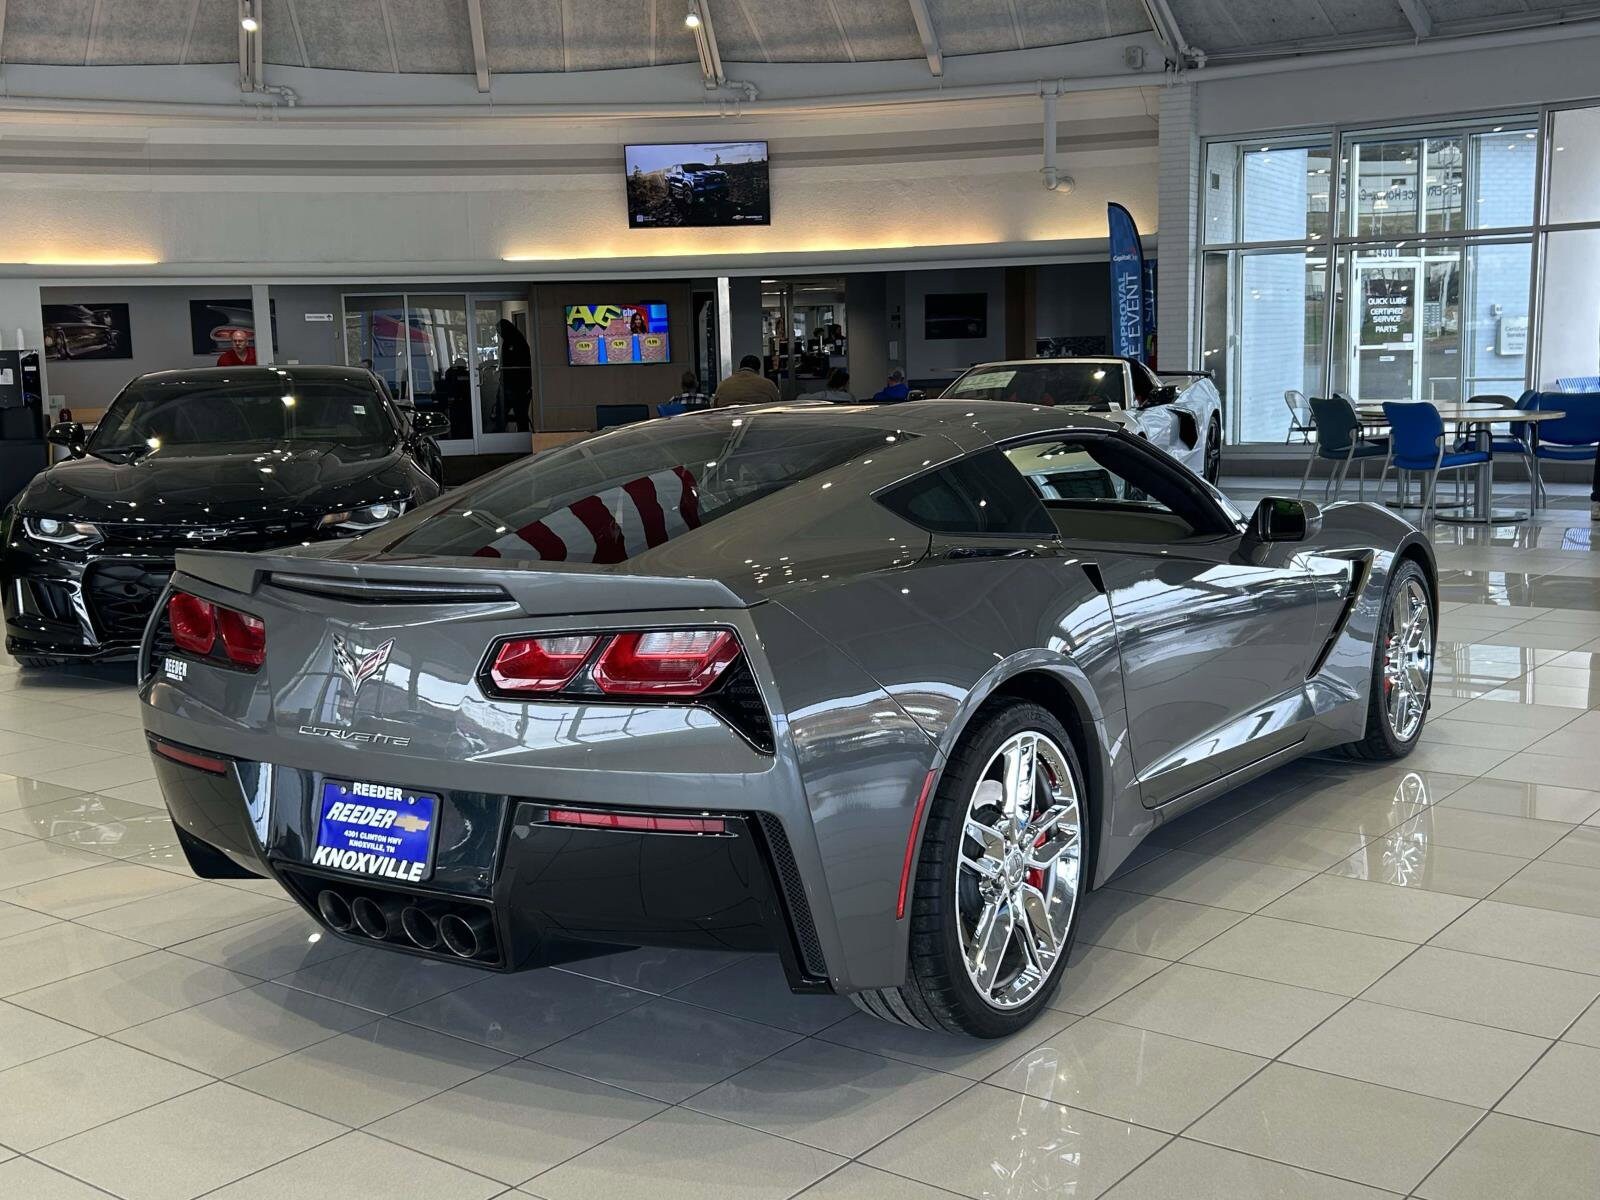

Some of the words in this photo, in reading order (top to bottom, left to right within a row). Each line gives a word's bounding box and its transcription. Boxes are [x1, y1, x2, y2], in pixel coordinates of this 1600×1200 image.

[1126, 272, 1140, 338] EVENT
[1367, 297, 1388, 305] QUICK
[1390, 297, 1408, 305] LUBE
[1118, 272, 1128, 357] APPROVAL
[1370, 307, 1404, 315] CERTIFIED
[1372, 315, 1402, 323] SERVICE
[1375, 325, 1399, 333] PARTS
[165, 658, 187, 677] REEDER
[298, 725, 411, 747] CORVETTE
[352, 782, 403, 801] REEDER
[326, 801, 397, 829] REEDER
[343, 830, 358, 838] 4301
[359, 831, 387, 843] CLINTON
[387, 836, 403, 846] HWY
[386, 845, 396, 854] TN
[312, 845, 426, 882] KNOXVILLE
